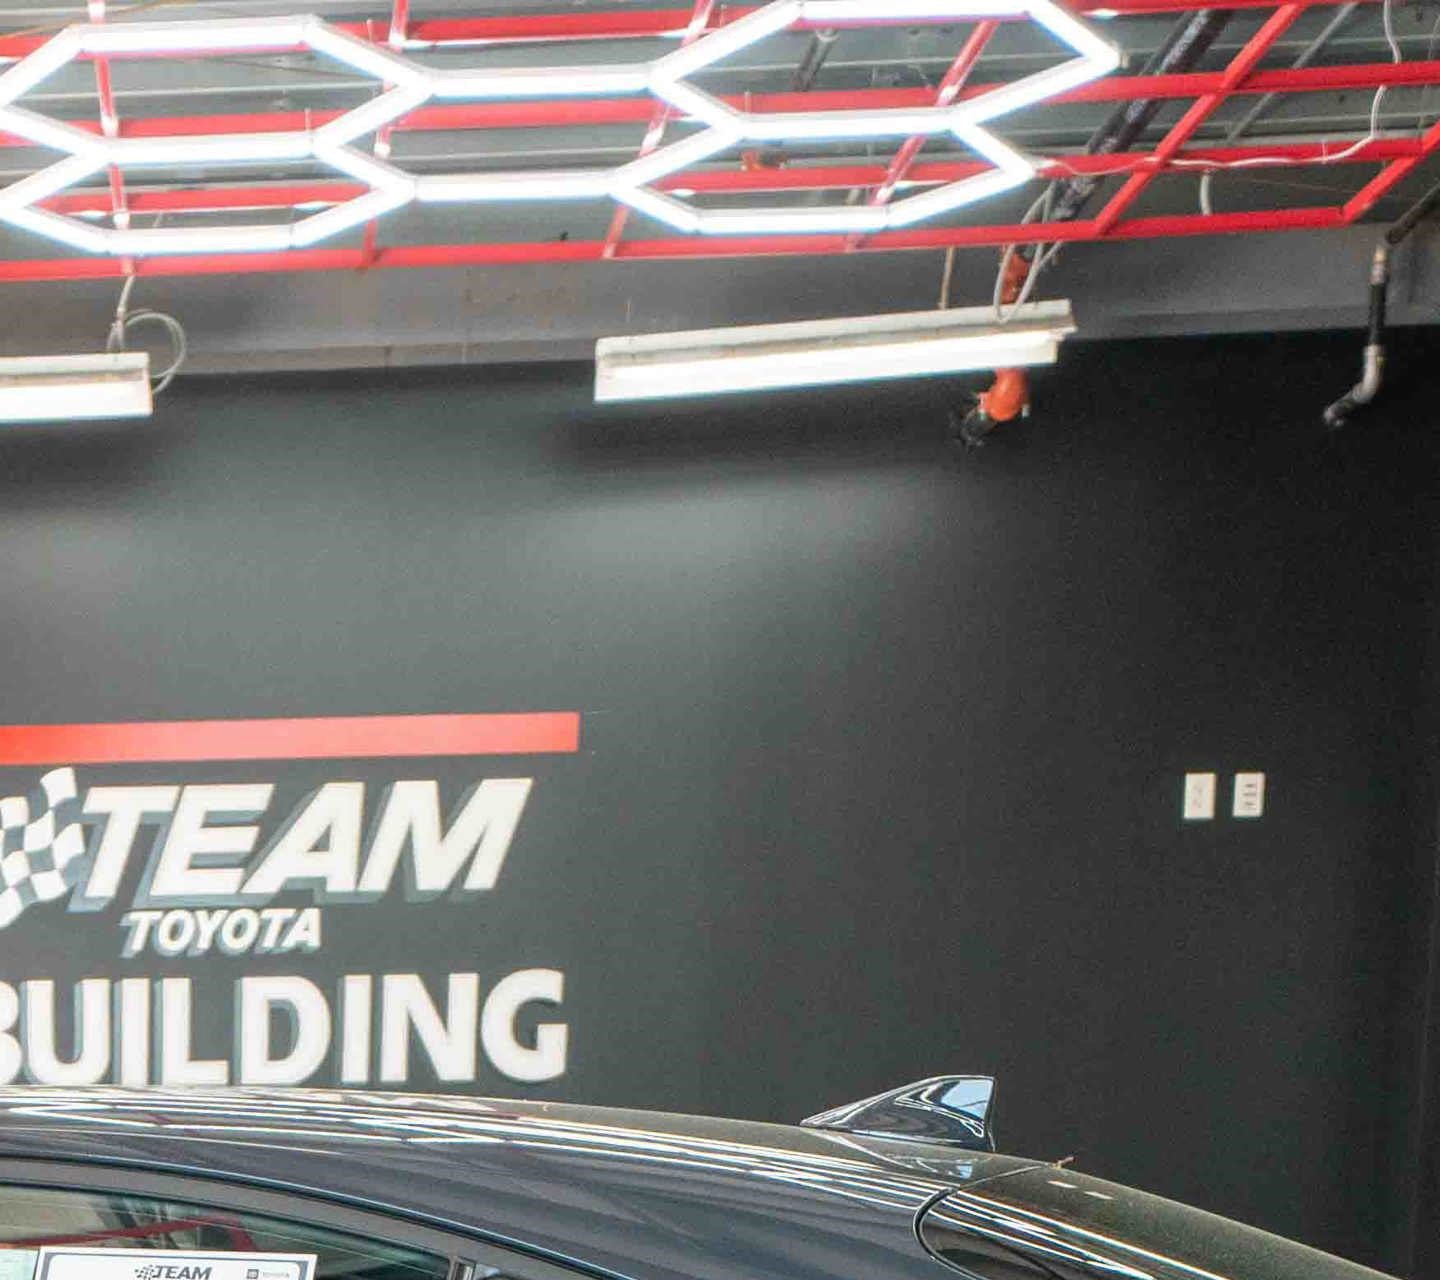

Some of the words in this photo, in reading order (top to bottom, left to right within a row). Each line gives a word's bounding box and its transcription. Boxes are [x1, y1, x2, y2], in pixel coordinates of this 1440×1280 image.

[75, 778, 533, 905] TEAM
[123, 908, 320, 957] TOYOTA
[154, 1264, 212, 1280] TEAM
